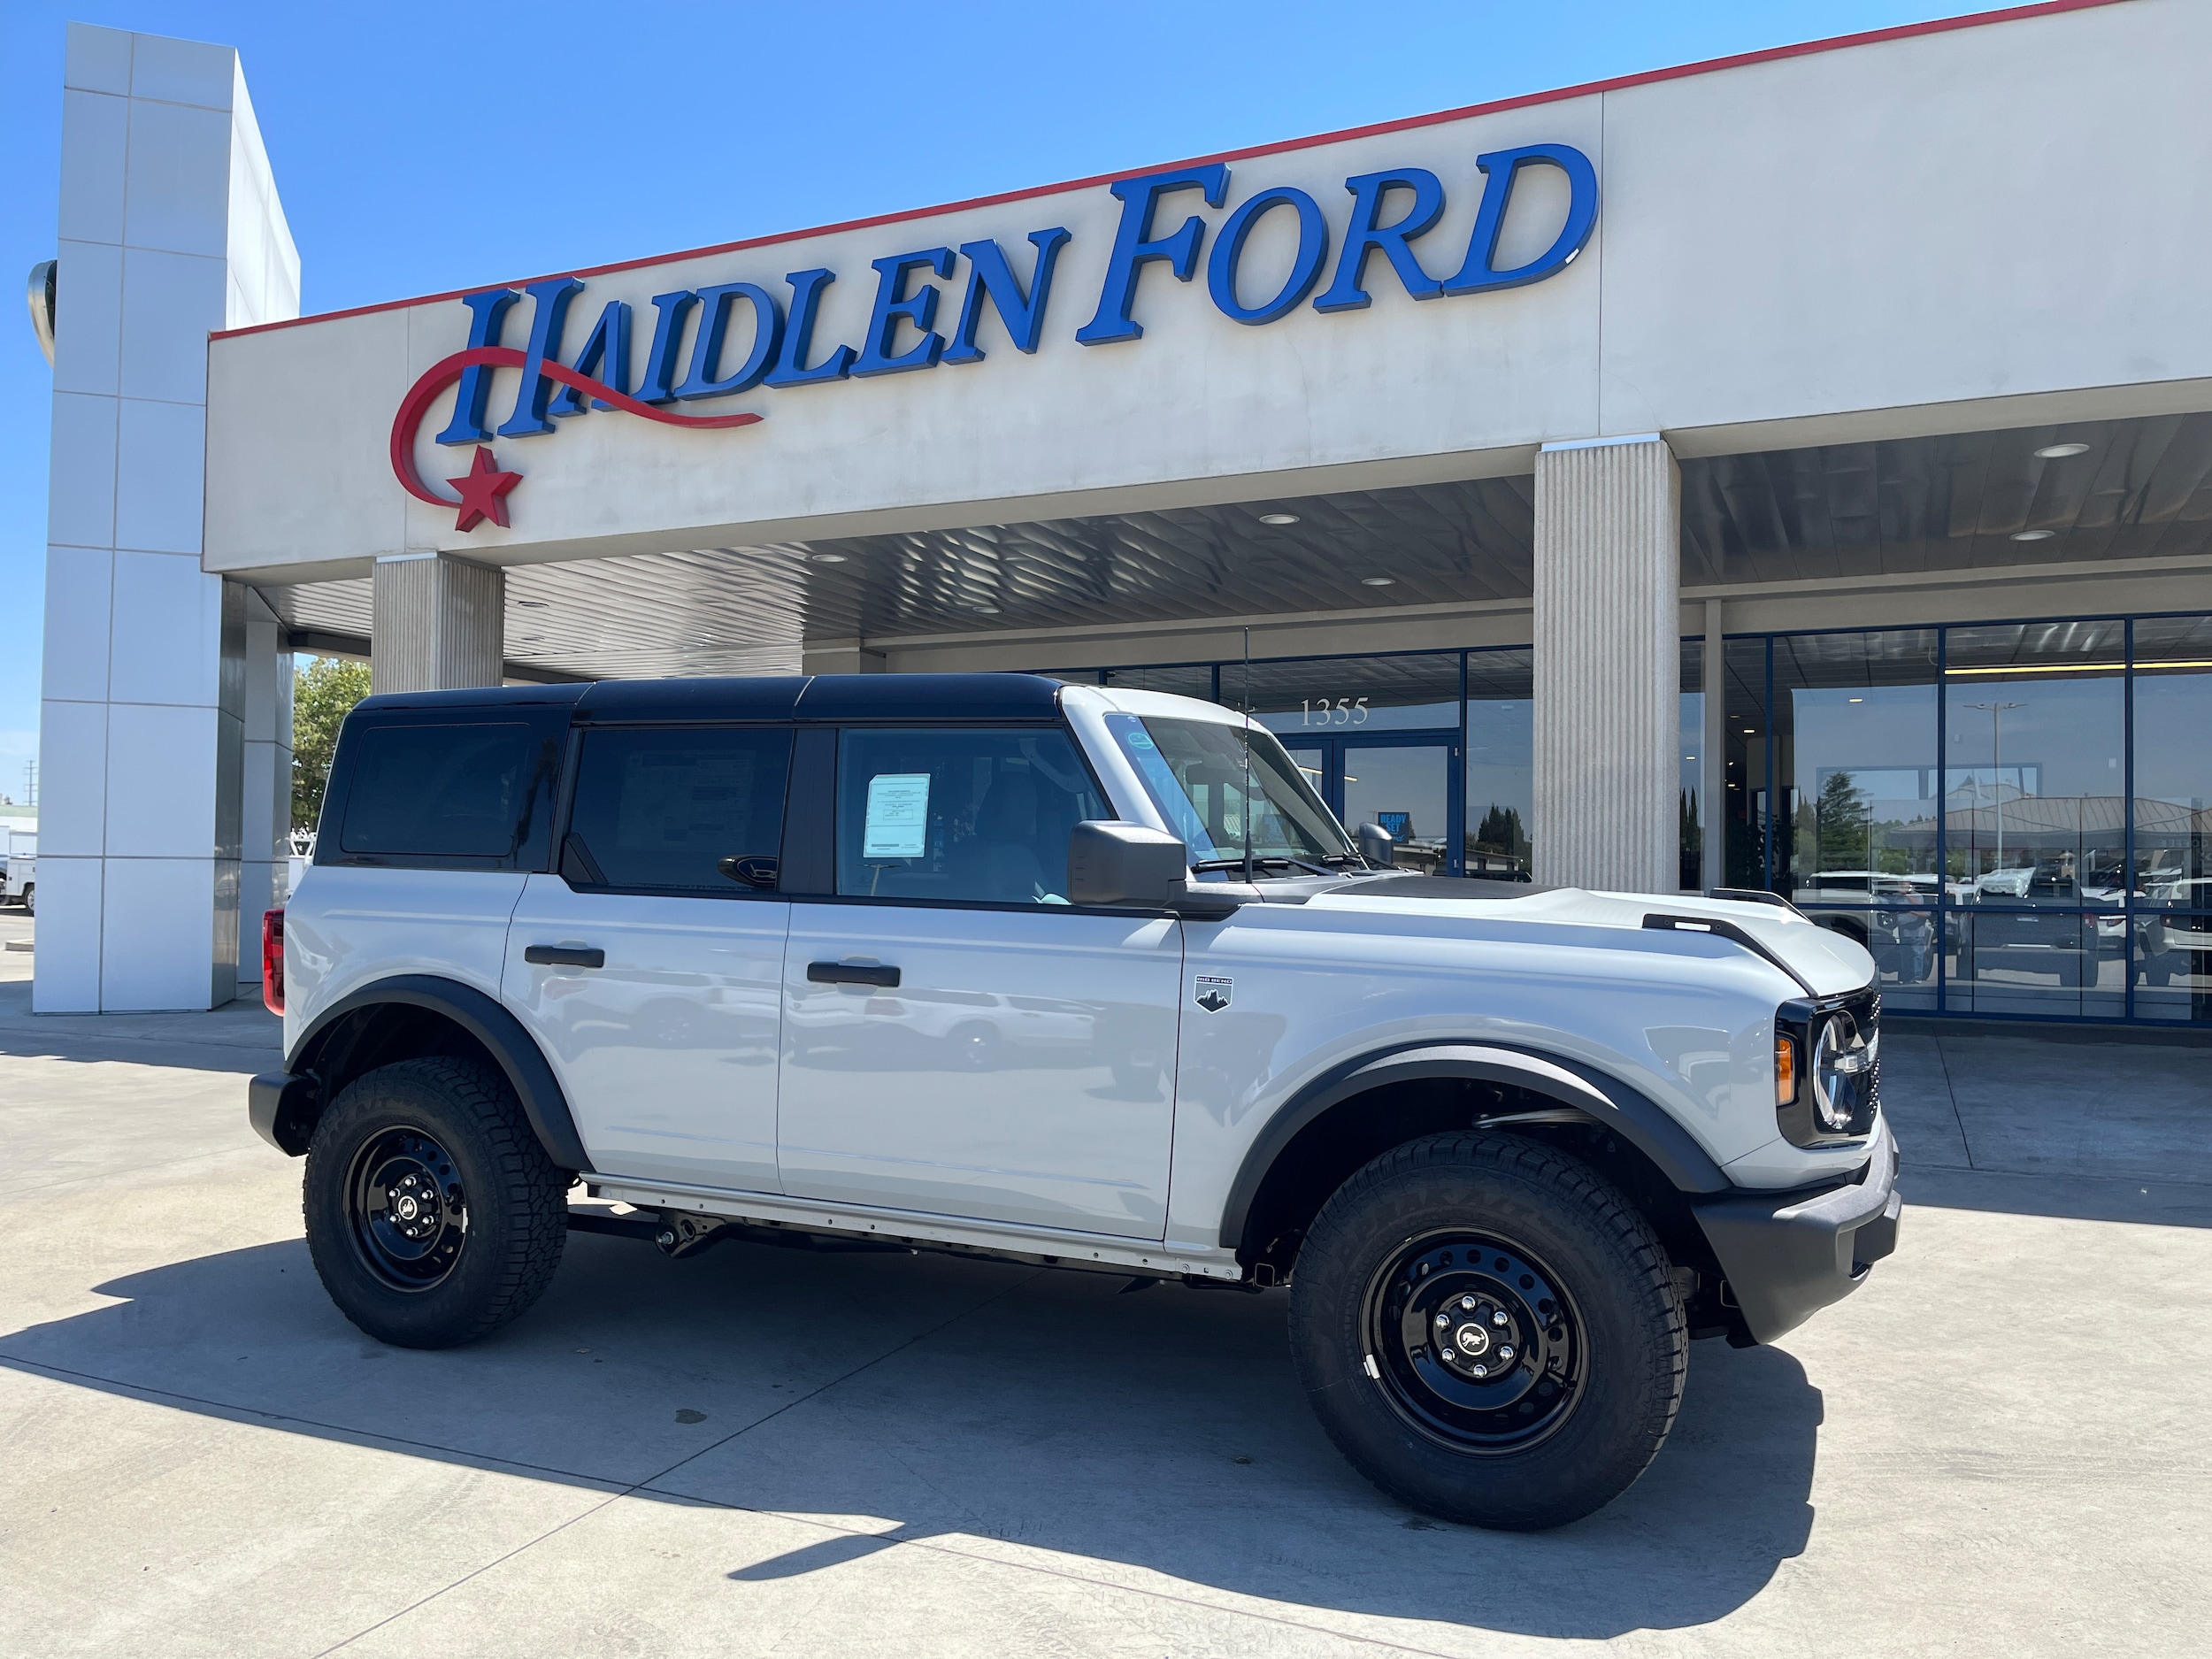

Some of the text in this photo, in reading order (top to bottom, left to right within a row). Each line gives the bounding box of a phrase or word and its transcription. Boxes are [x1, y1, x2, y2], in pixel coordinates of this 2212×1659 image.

[435, 142, 1599, 446] HAIDLEN FORD
[1301, 696, 1370, 726] 1355
[1380, 814, 1406, 823] READY
[1386, 823, 1400, 832] SET
